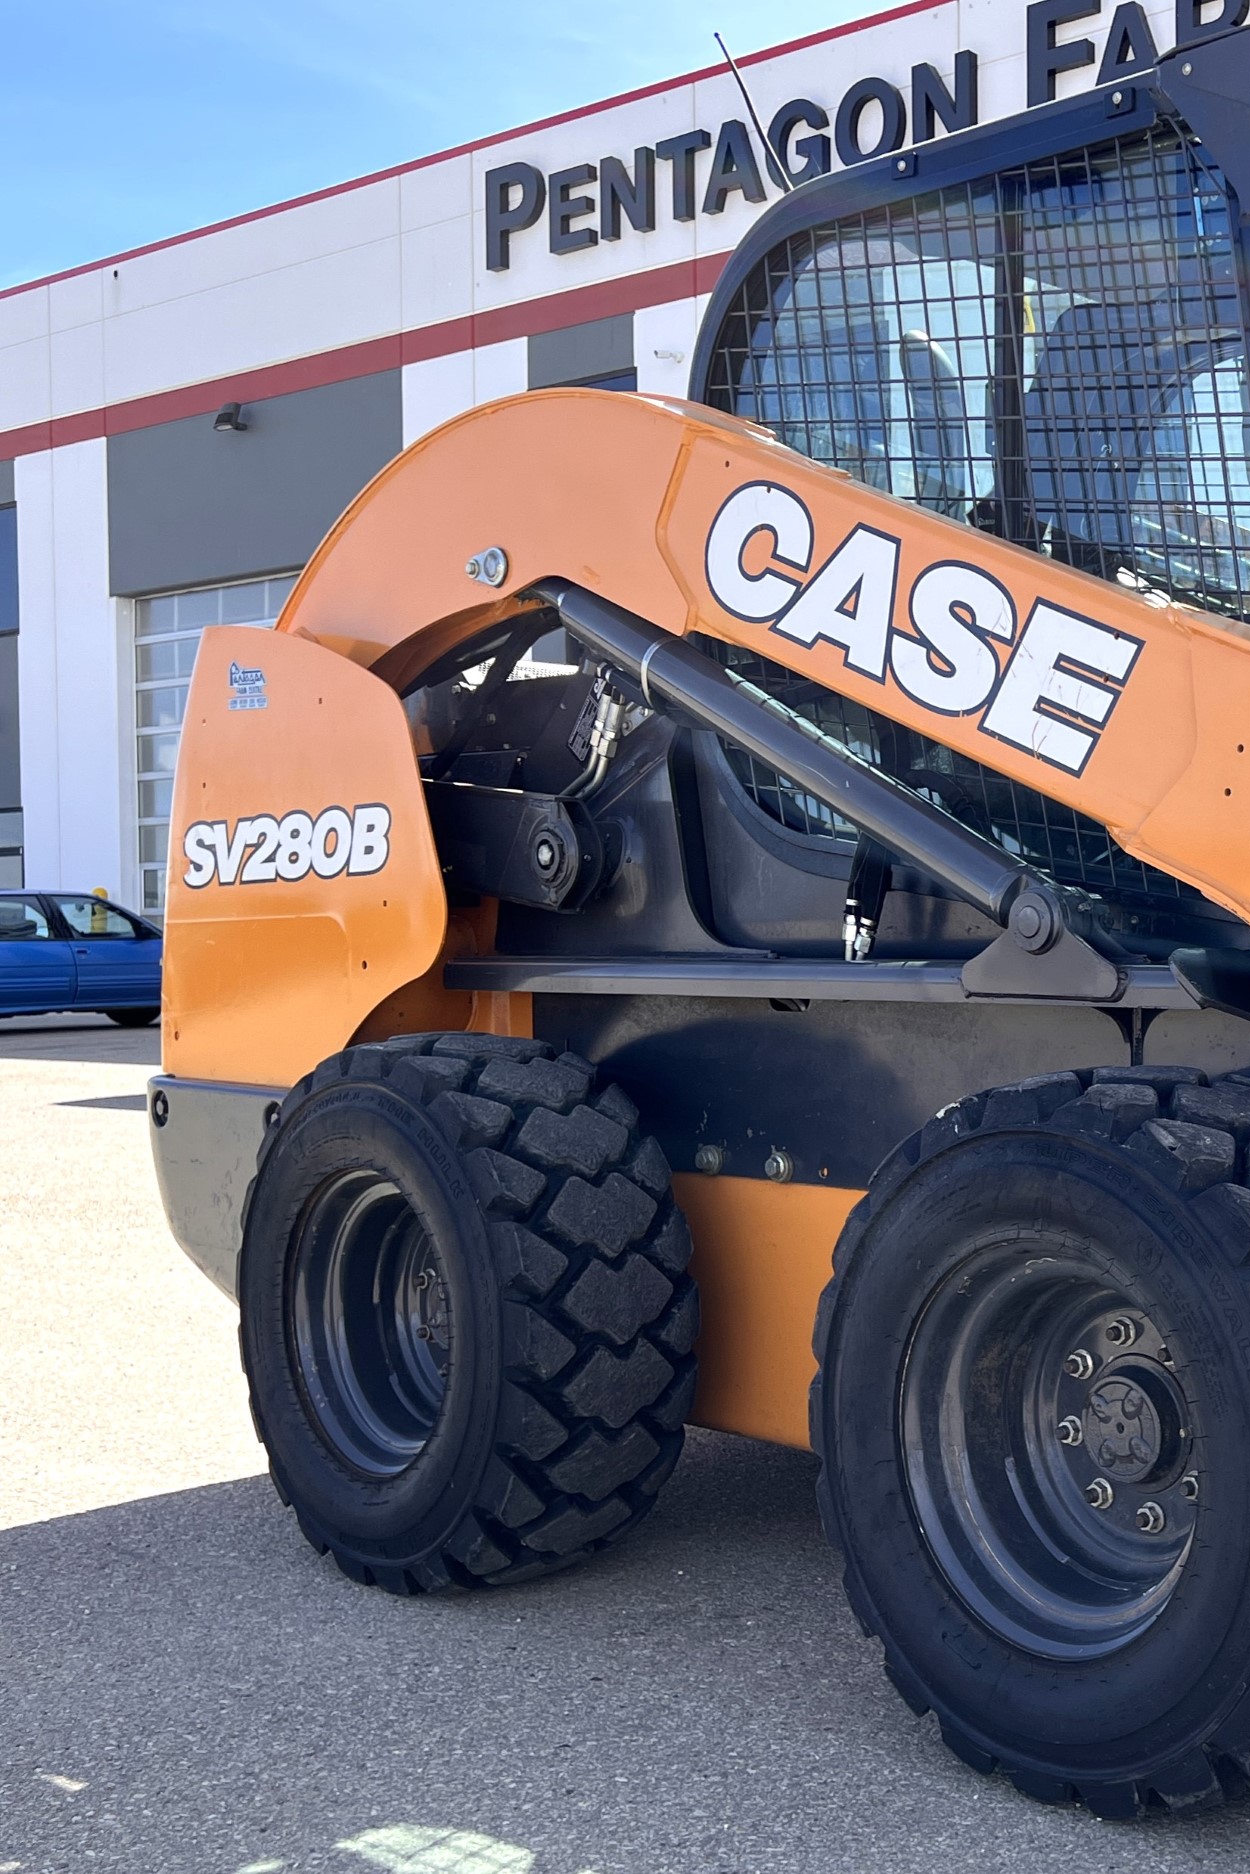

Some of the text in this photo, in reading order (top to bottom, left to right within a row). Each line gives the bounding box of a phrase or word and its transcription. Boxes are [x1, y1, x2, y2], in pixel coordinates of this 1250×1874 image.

[485, 49, 978, 272] PENTAGON
[704, 479, 1146, 778] CASE
[183, 803, 391, 888] SV280B
[416, 1127, 465, 1200] HULK
